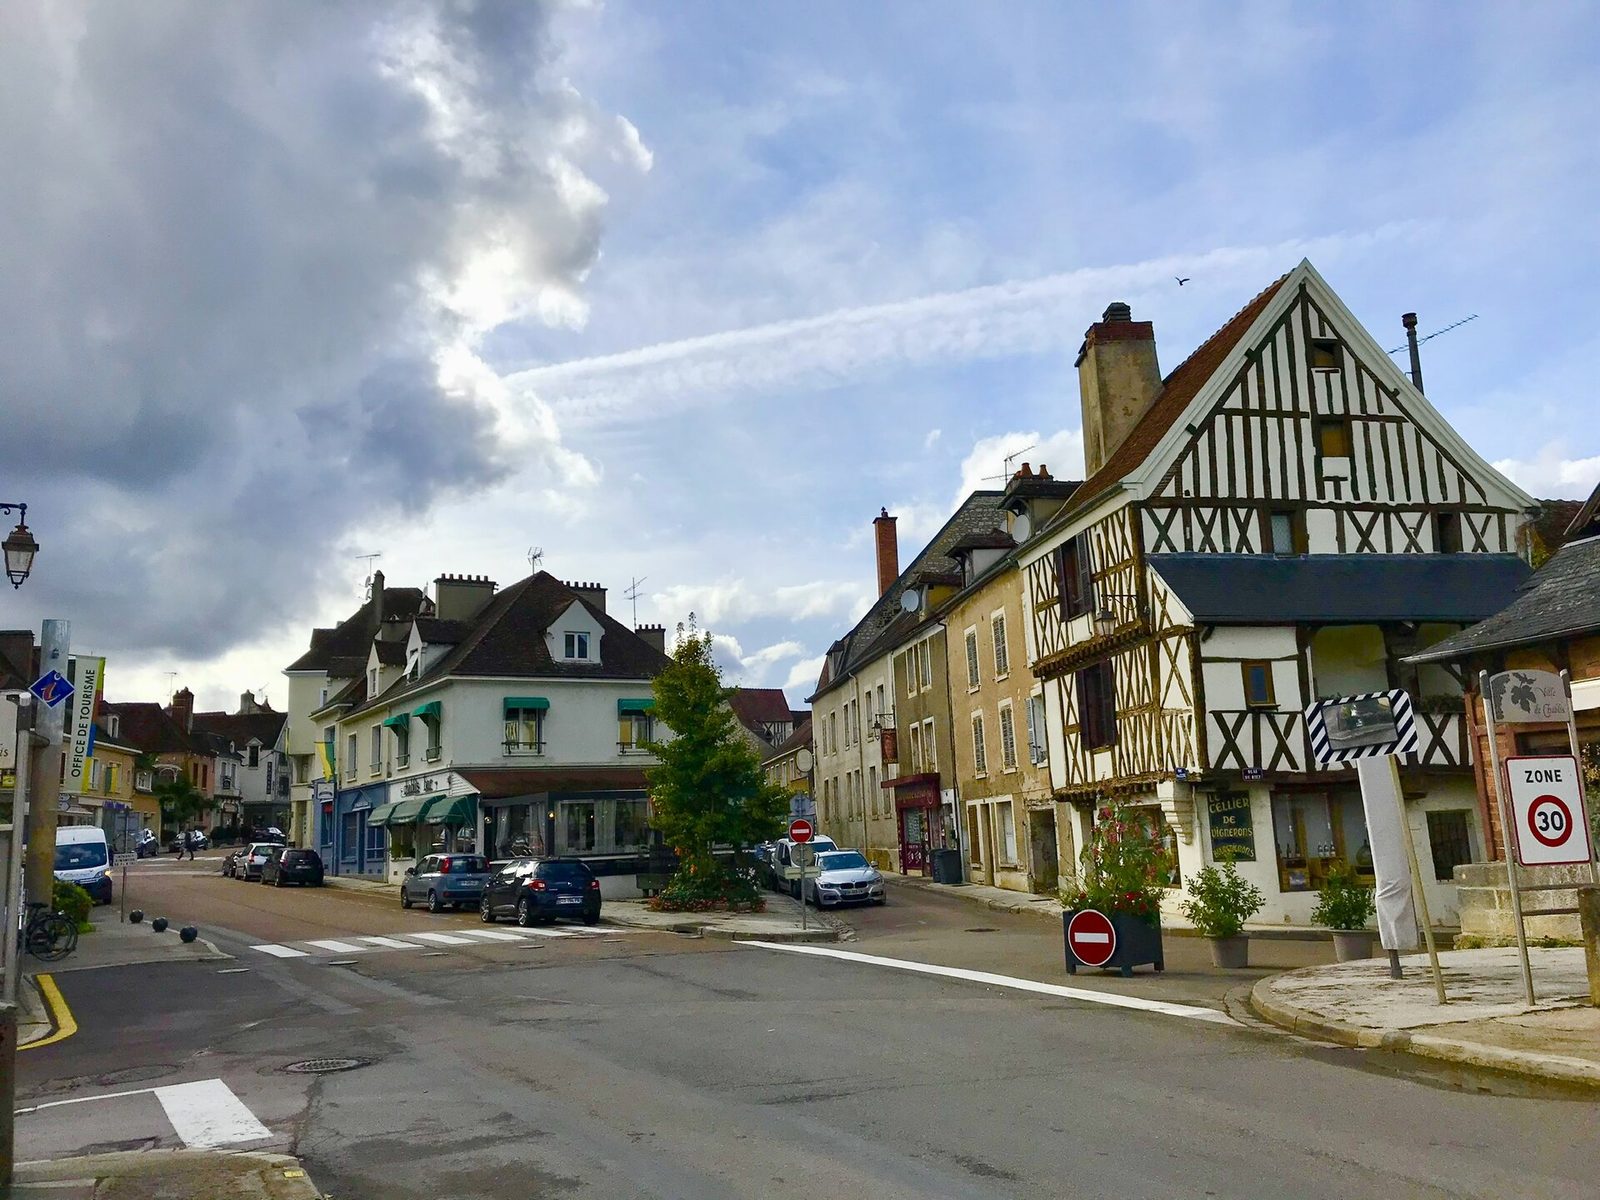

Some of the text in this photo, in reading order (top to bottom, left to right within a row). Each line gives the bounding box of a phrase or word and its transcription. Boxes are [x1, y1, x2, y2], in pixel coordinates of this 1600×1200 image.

[71, 668, 96, 778] OFFICE DE TOURISME
[1524, 769, 1563, 784] ZONE
[1209, 797, 1249, 814] CELLIER
[1222, 815, 1237, 824] DE
[1537, 810, 1564, 832] 30
[1211, 827, 1253, 838] VIGNERONS
